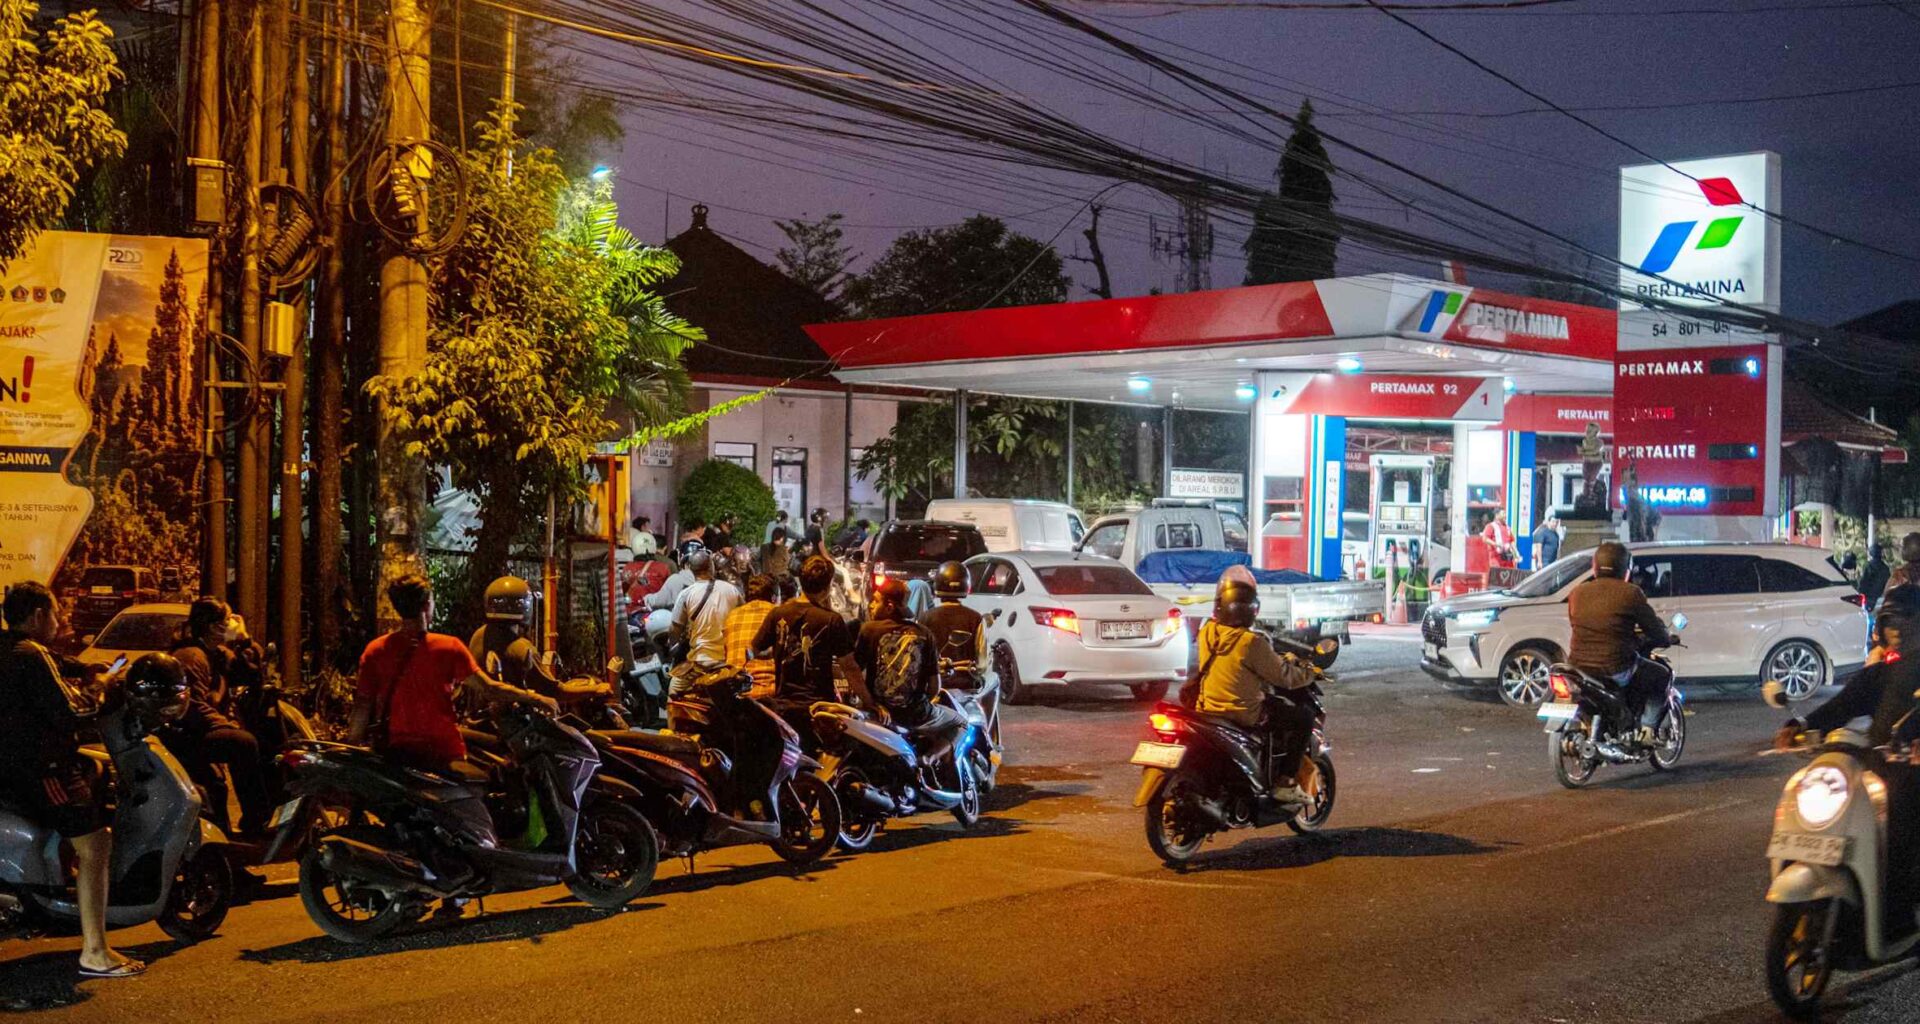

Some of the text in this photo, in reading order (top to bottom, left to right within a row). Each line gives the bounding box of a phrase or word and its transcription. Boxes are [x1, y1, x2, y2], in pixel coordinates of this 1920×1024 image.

[1637, 278, 1745, 297] PERTAMINA
[1465, 302, 1569, 340] PERTAMINA
[0, 326, 35, 338] AJAK?
[1652, 323, 1667, 336] 54
[1679, 322, 1700, 335] 801
[1619, 360, 1704, 376] PERTAMAX
[1370, 382, 1488, 406] PERTAMAX 92 1
[1557, 408, 1610, 421] PERTALITE
[1172, 474, 1240, 485] DILARANG MEROKOK
[1186, 485, 1210, 494] AREAL
[22, 504, 79, 512] SETERUSNYA
